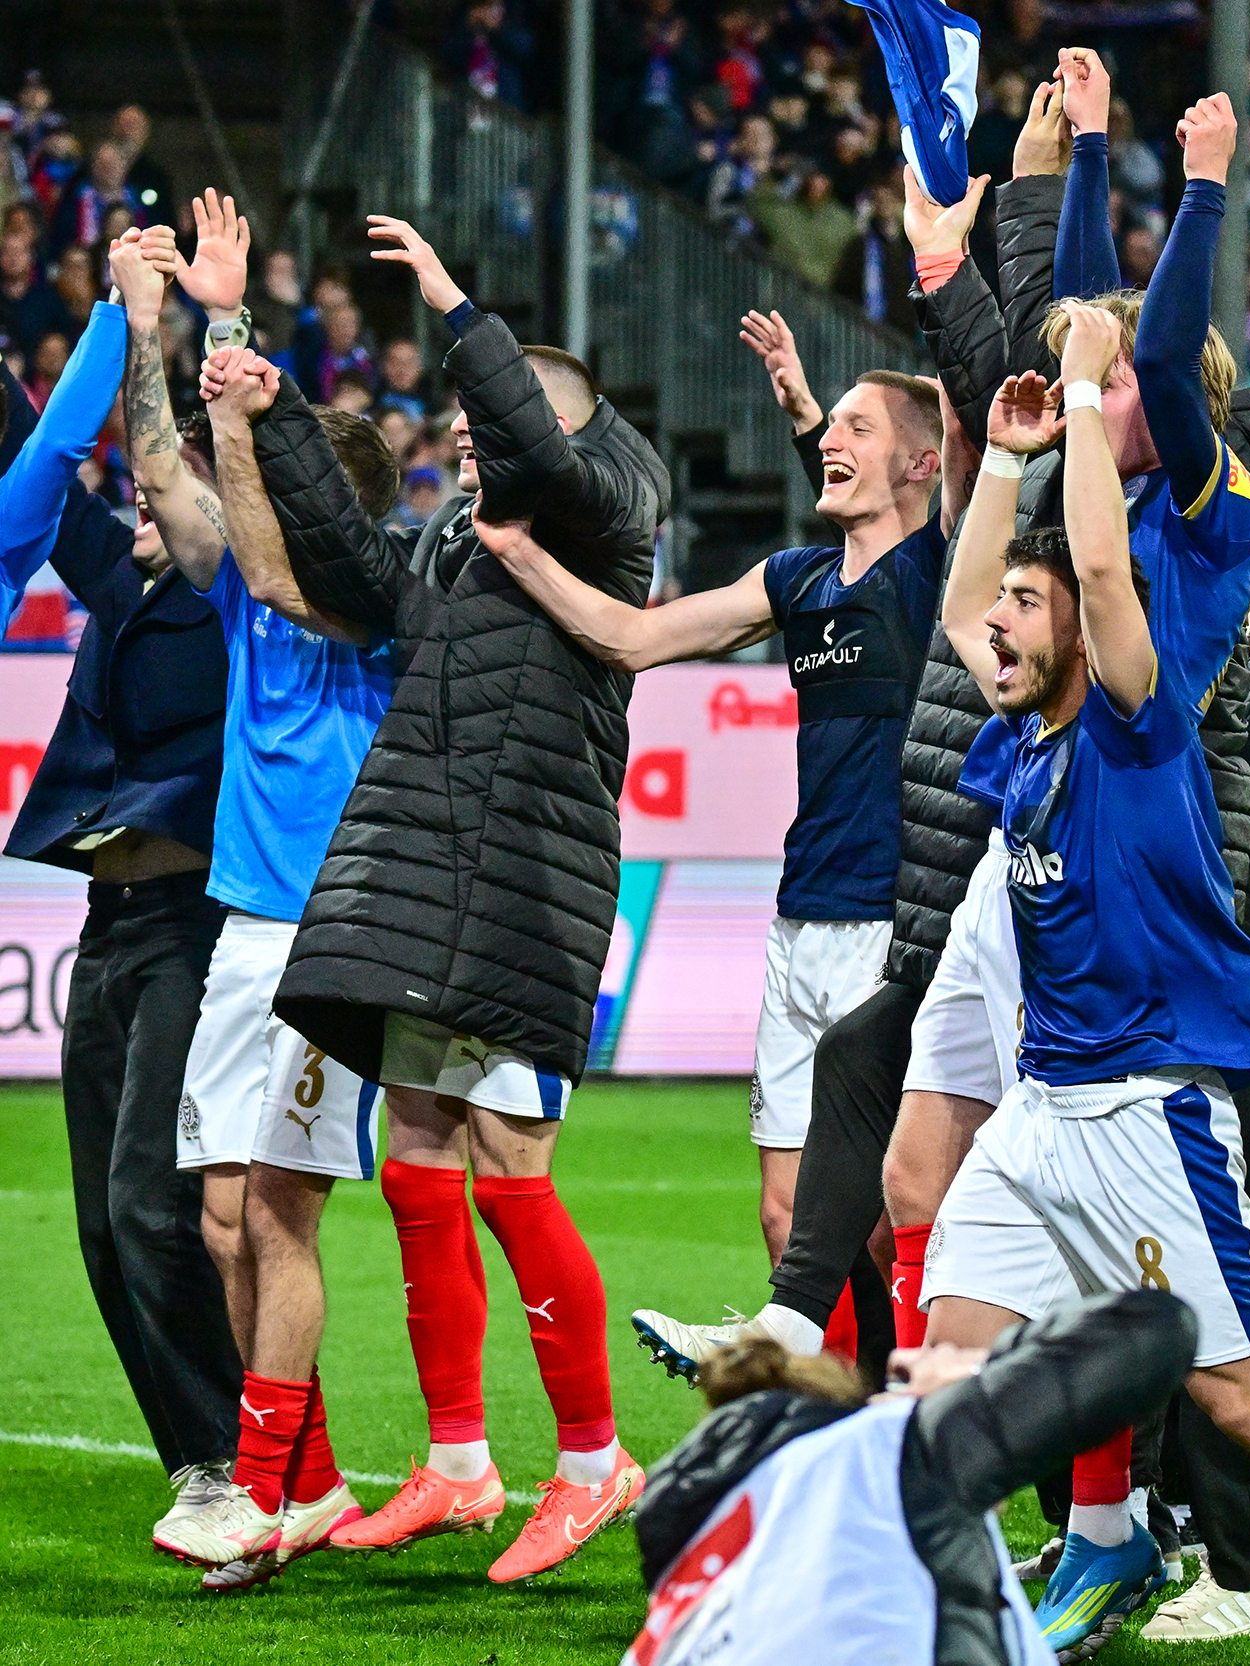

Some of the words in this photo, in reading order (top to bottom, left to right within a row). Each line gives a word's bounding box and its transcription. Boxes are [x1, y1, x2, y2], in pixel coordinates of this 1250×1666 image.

[794, 646, 863, 673] CATAPULT
[294, 1042, 327, 1109] 3
[1135, 1236, 1171, 1294] 8
